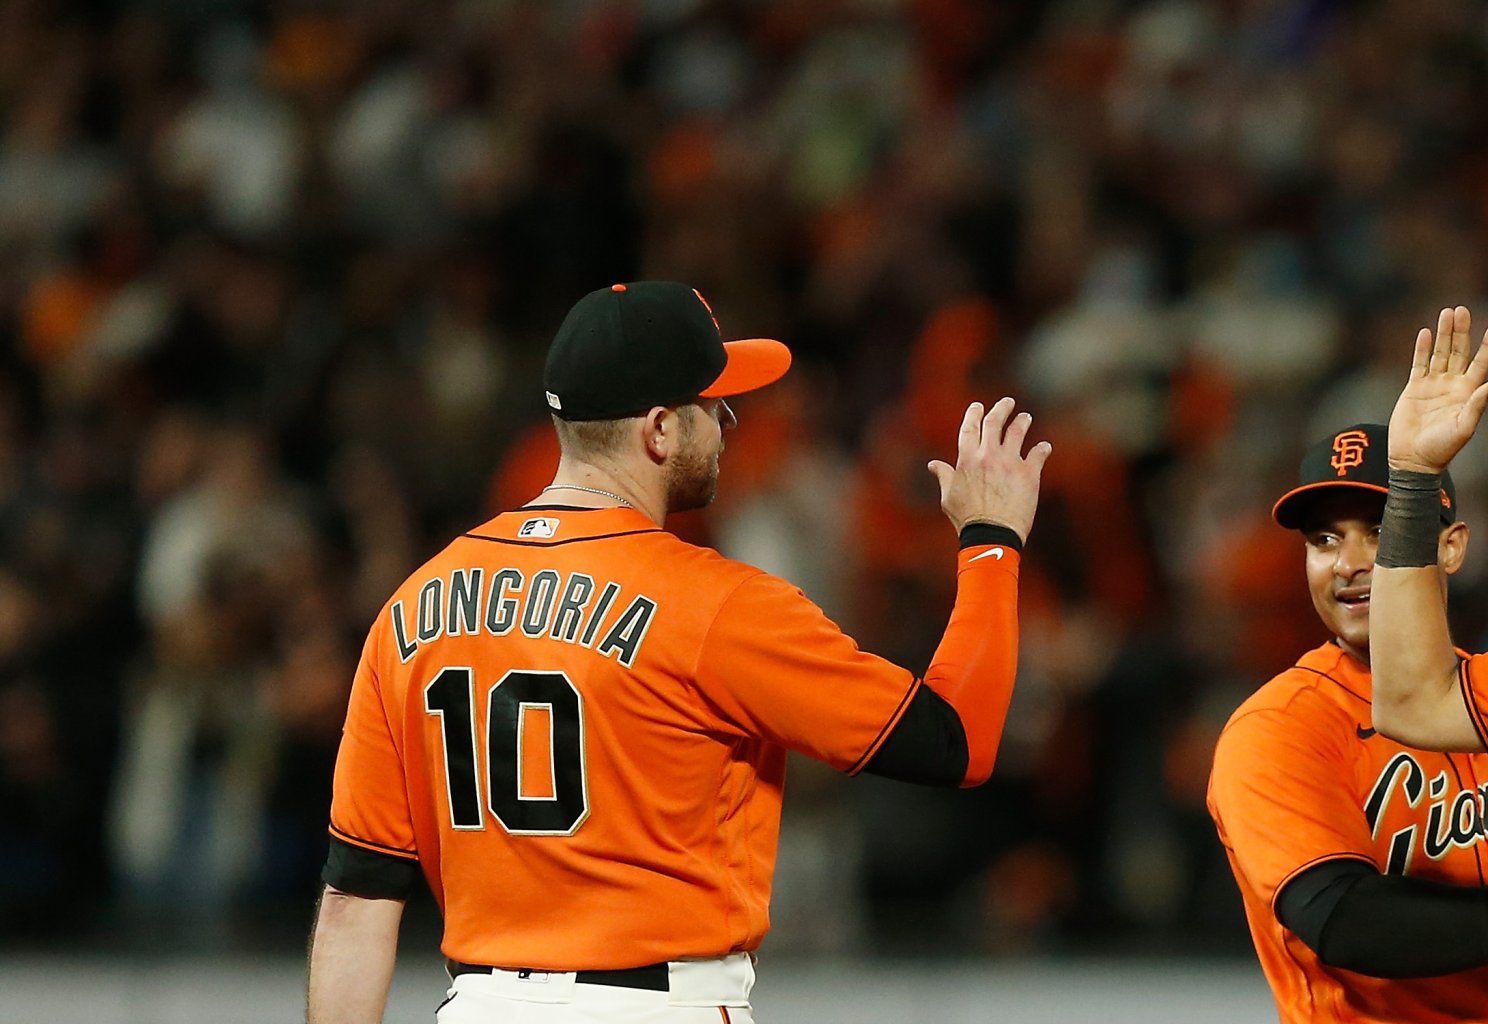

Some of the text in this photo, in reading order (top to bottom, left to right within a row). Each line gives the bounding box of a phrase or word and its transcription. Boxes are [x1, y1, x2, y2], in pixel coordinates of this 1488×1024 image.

[1329, 429, 1370, 477] SF
[392, 567, 659, 670] LONGORIA
[424, 665, 592, 837] 10
